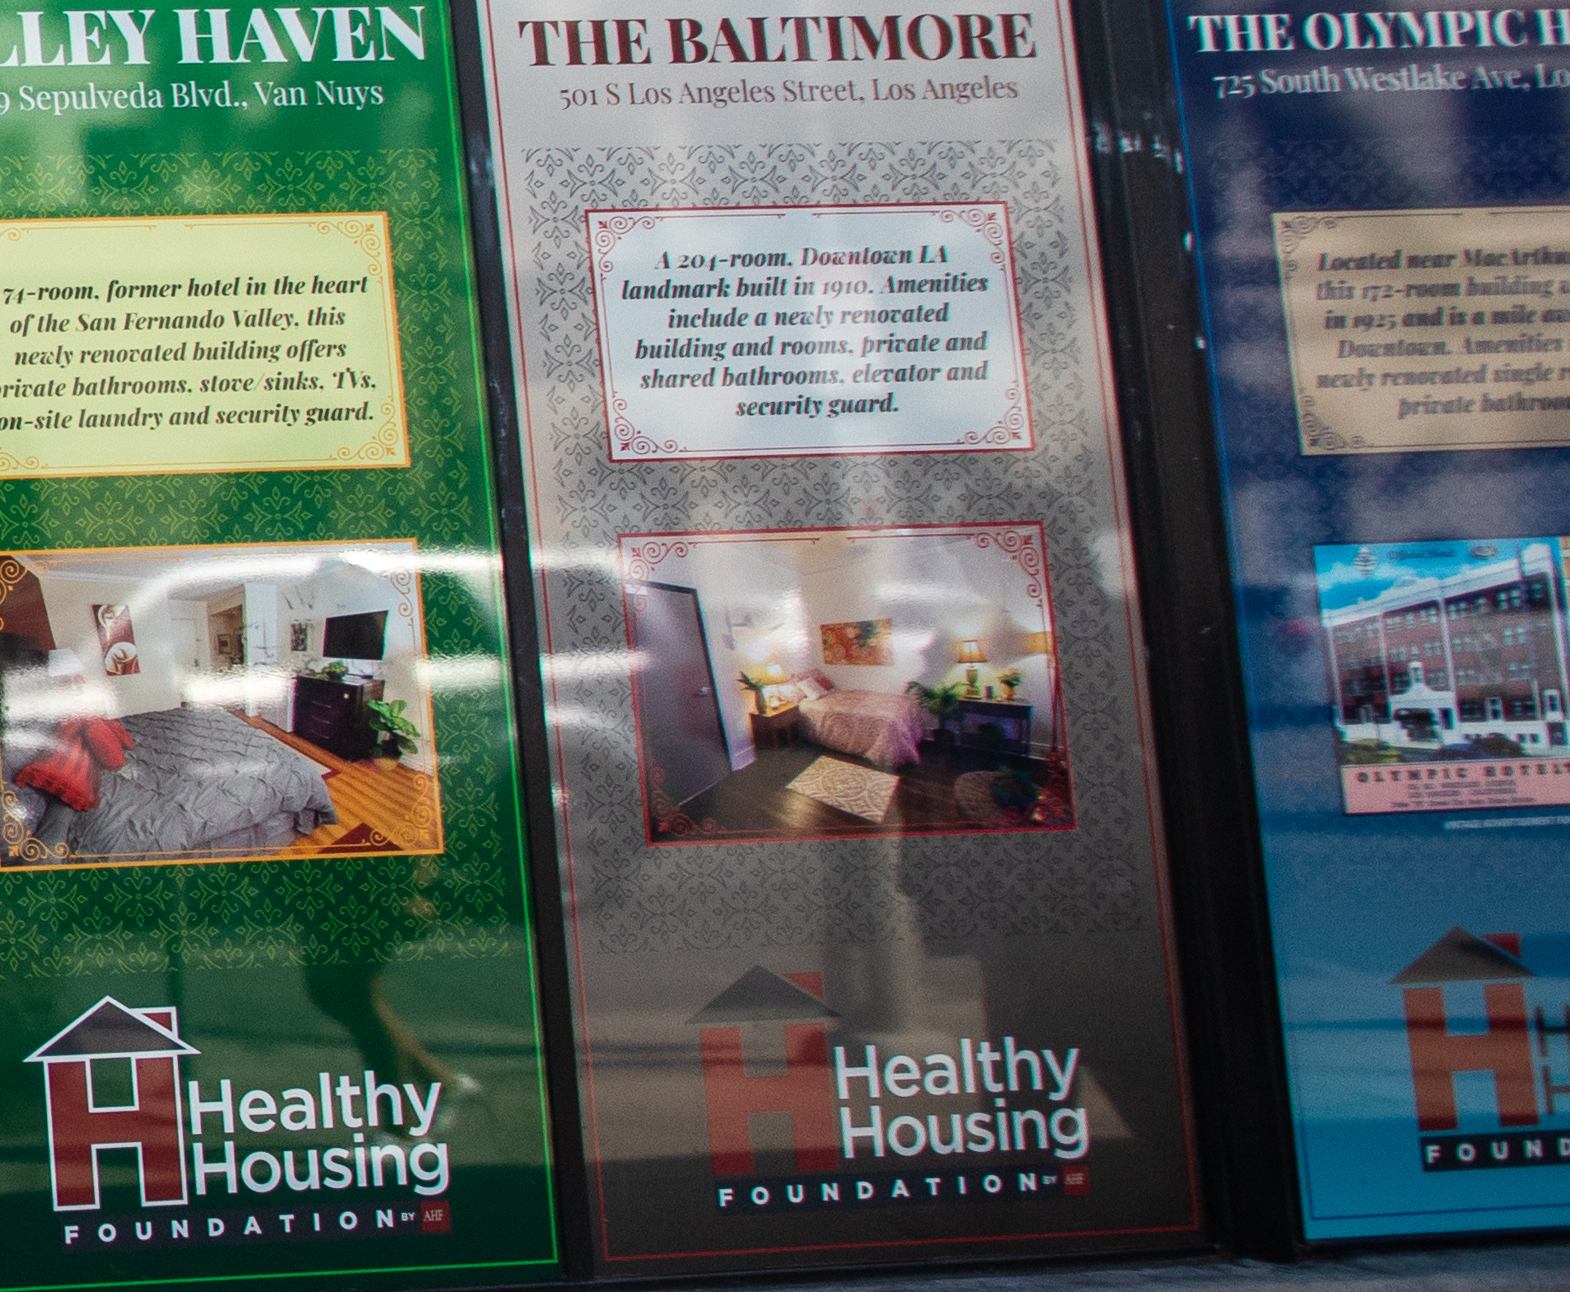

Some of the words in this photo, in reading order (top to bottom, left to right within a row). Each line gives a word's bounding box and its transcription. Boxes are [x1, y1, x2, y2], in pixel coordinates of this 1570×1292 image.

[175, 4, 426, 64] HAVEN
[518, 18, 652, 67] THE
[668, 12, 1037, 64] BALTIMORE
[1189, 13, 1295, 53] THE
[1305, 9, 1527, 51] OLYMPIC
[19, 80, 165, 116] Sepulveda
[171, 79, 249, 110] Blvd.,
[253, 80, 308, 107] Van
[315, 80, 386, 111] Nuys
[559, 88, 599, 110] 501
[605, 82, 621, 106] S
[628, 82, 673, 106] Los
[679, 78, 776, 109] Angeles
[782, 79, 866, 104] Street,
[872, 77, 917, 102] Los
[921, 74, 1020, 105] Angeles
[1213, 74, 1256, 99] 725
[1261, 65, 1341, 94] South
[1343, 62, 1467, 92] Westlake
[1473, 63, 1532, 92] Ave,
[9, 313, 36, 338] of
[37, 312, 71, 333] the
[77, 314, 117, 332] San
[123, 308, 225, 331] Fernando
[232, 307, 300, 332] Valley,
[307, 306, 346, 327] this
[668, 306, 749, 329] include
[754, 312, 768, 327] a
[774, 305, 834, 329] newly
[841, 301, 950, 324] renovated
[14, 344, 74, 369] newly
[79, 341, 187, 364] renovated
[192, 339, 282, 363] building
[286, 338, 347, 363] offers
[78, 406, 164, 431] laundry
[168, 405, 211, 426] and
[215, 402, 301, 428] security
[304, 400, 374, 427] guard.
[835, 1036, 1079, 1108] Healthy
[188, 1072, 441, 1141] Healthy
[840, 1097, 1091, 1161] Housing
[193, 1132, 450, 1197] Housing
[720, 1172, 1037, 1208] FOUNDATION
[64, 1208, 394, 1245] FOUNDATION
